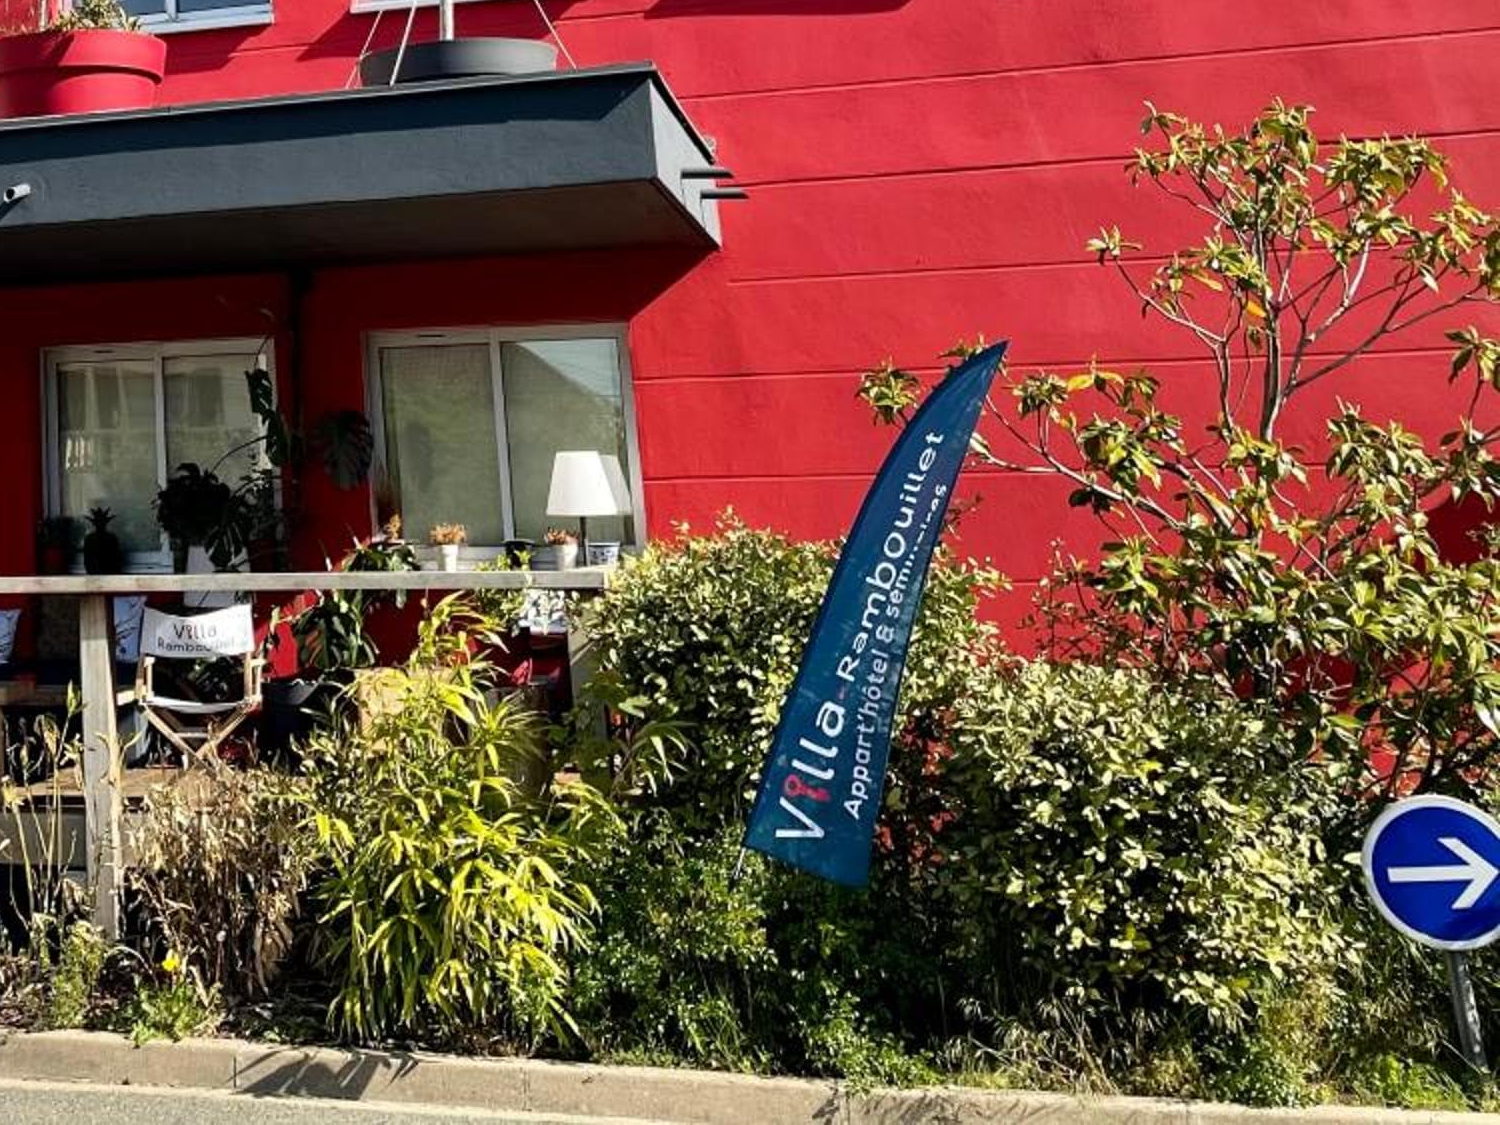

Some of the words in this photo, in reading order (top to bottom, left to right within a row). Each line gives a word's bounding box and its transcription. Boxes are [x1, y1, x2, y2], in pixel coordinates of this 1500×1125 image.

[173, 623, 217, 640] Villa
[775, 700, 845, 839] Villa
[836, 431, 944, 682] Rambouillet
[875, 625, 895, 643] &
[157, 636, 236, 652] Rambou
